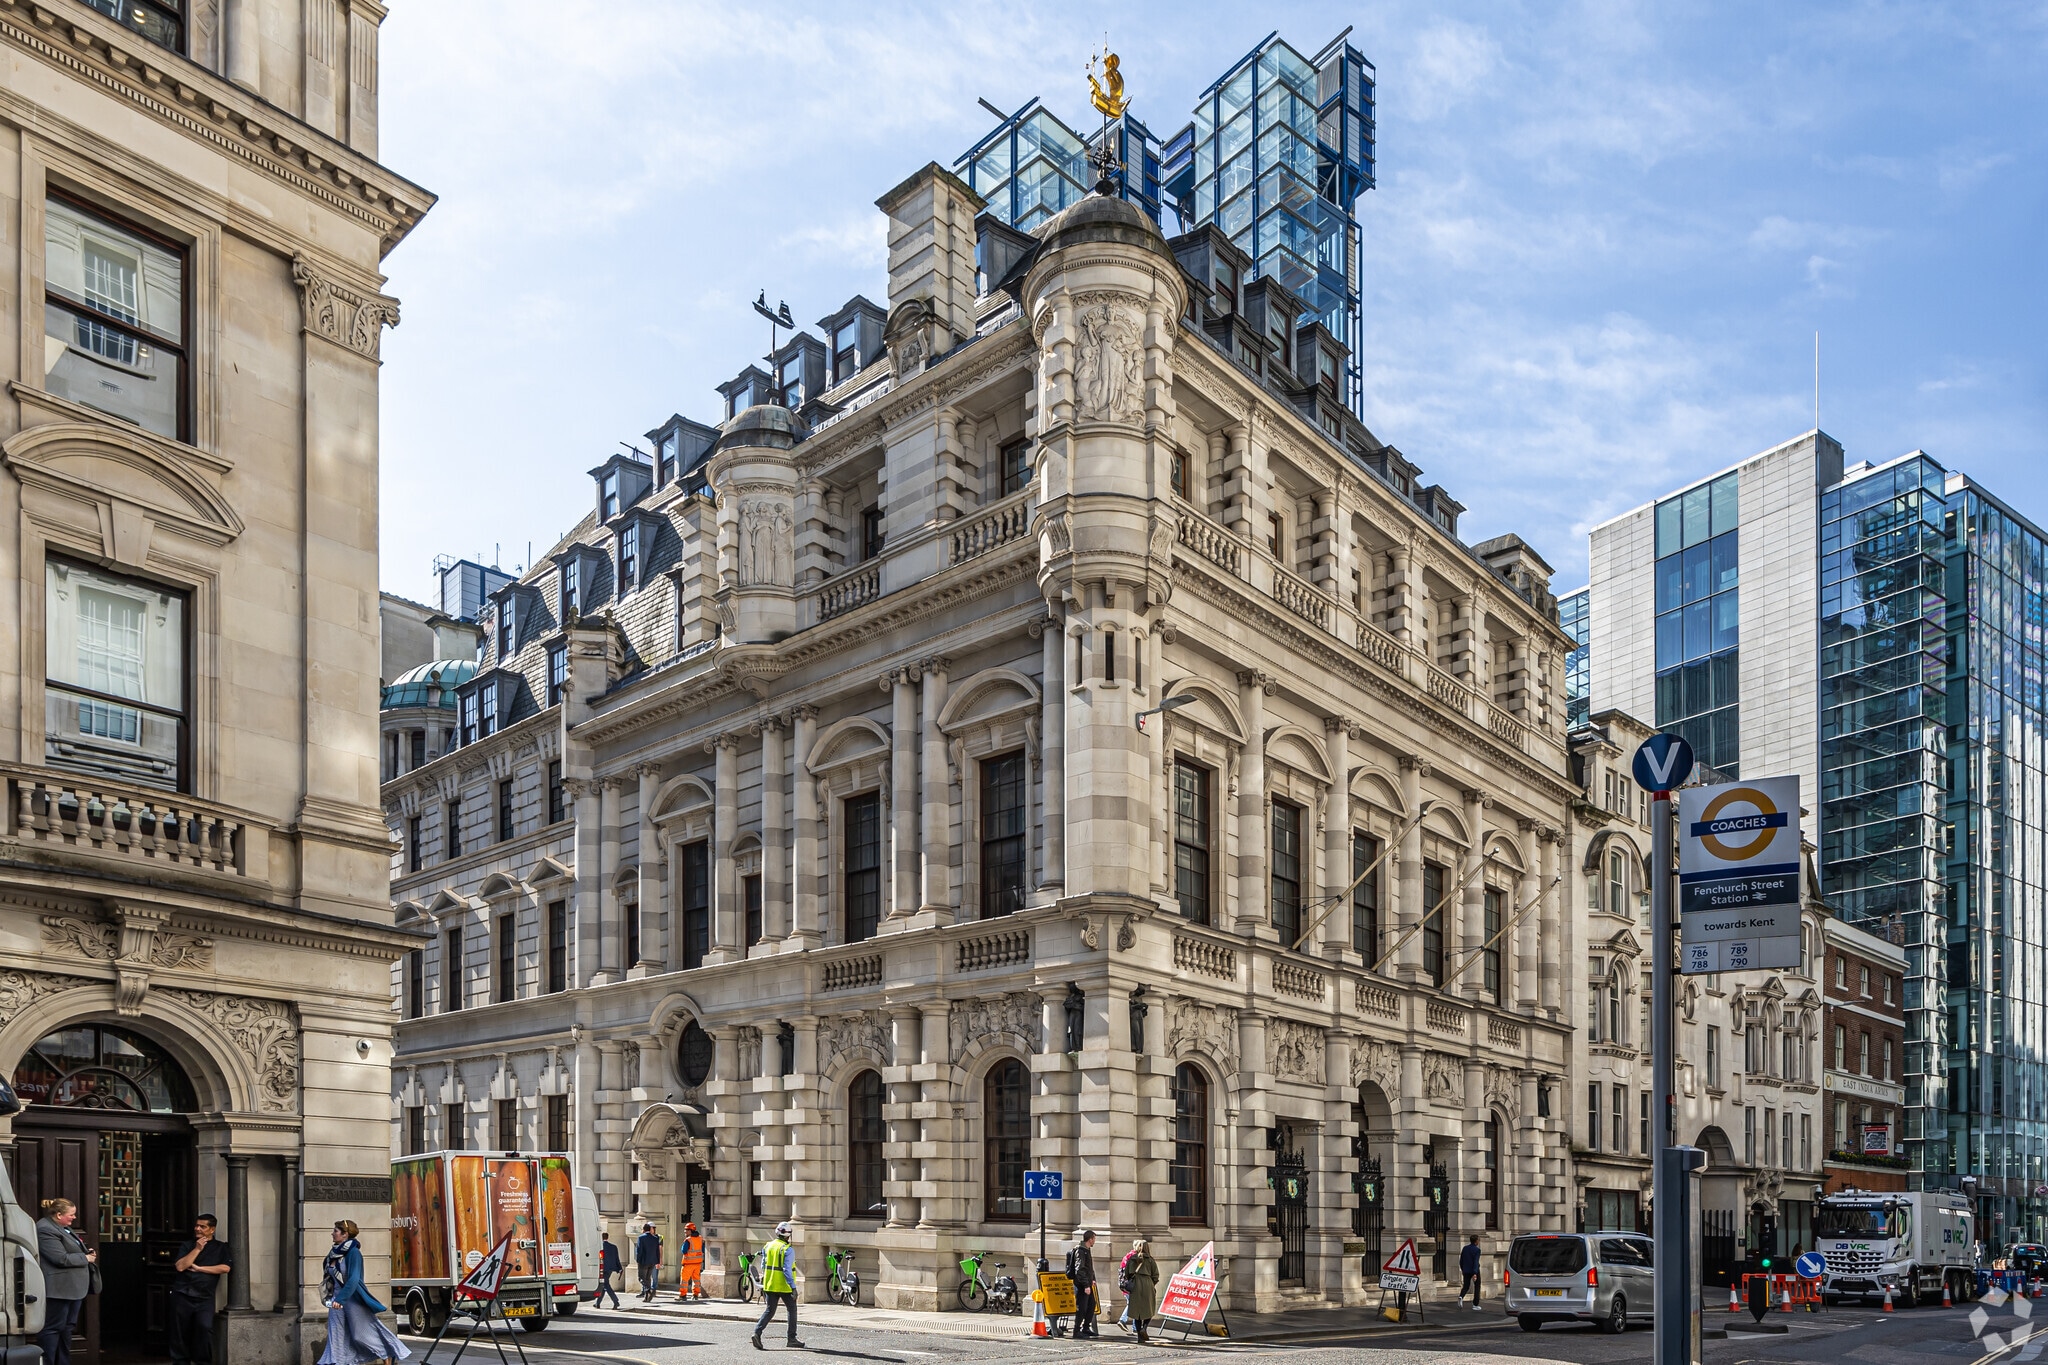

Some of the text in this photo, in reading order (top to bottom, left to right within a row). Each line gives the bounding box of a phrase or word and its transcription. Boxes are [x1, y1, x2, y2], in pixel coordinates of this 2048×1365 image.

[1642, 741, 1681, 784] V
[1710, 817, 1767, 832] COACHES
[1694, 880, 1785, 896] Fenchurch Street
[1711, 894, 1749, 905] Station
[1704, 918, 1775, 931] towards Kent
[1691, 949, 1708, 958] 786
[1730, 946, 1748, 955] 789
[1691, 960, 1708, 969] 788
[1730, 957, 1748, 967] 790
[1842, 1079, 1889, 1097] EAST INDIA ARMS
[311, 1177, 387, 1188] DIXON HOUSE
[498, 1197, 532, 1205] guaranteed
[1943, 1228, 1952, 1244] DB
[1173, 1279, 1213, 1291] NARROW LANE
[1382, 1274, 1416, 1285] Single file
[1387, 1282, 1408, 1290] traffic
[1169, 1286, 1210, 1300] PLEASE DO NOT
[1172, 1296, 1201, 1308] OVERTAKE
[520, 1307, 533, 1315] KLS
[1170, 1304, 1196, 1315] CYCLISTS
